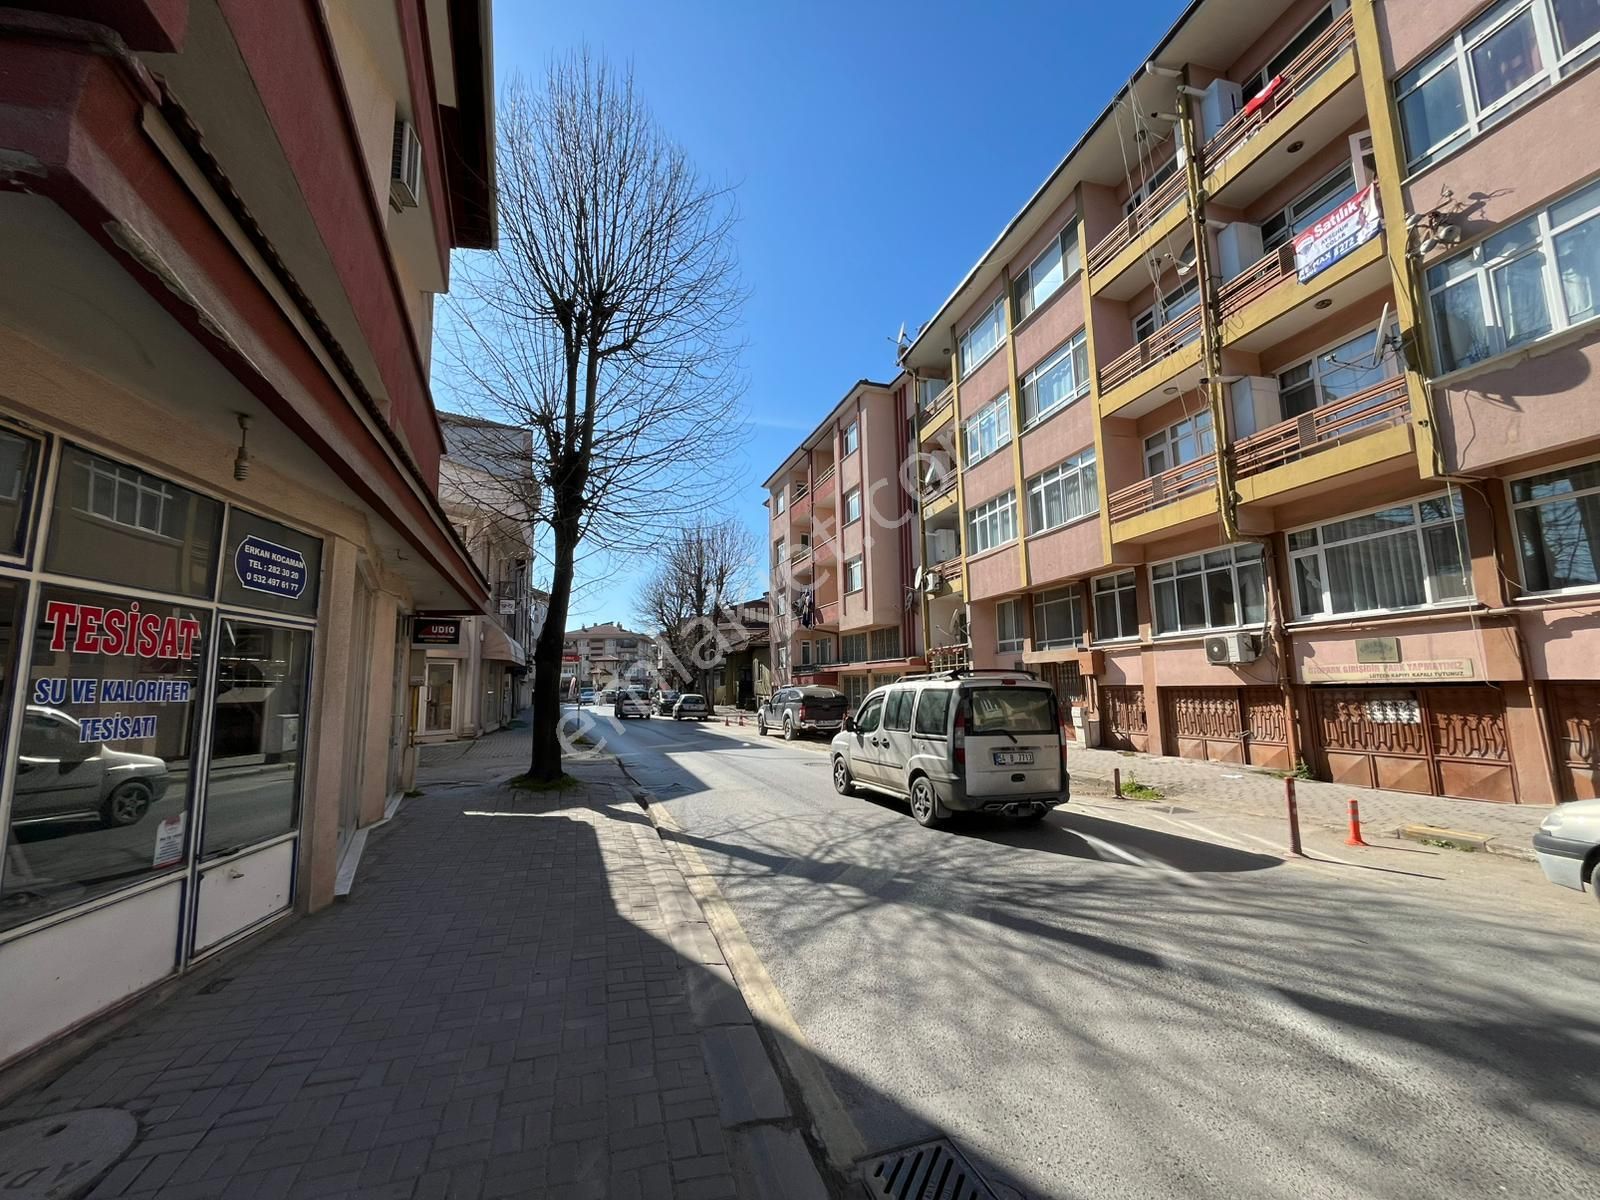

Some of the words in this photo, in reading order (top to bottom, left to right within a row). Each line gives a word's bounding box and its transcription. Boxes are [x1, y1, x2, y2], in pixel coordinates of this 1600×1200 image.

[1313, 201, 1359, 238] Satılık
[244, 544, 271, 559] ERKAN
[271, 553, 304, 569] KOCAMAN
[248, 559, 262, 570] TEL
[267, 564, 281, 575] 282
[281, 568, 290, 577] 30
[290, 571, 299, 580] 20
[252, 574, 267, 584] 532
[267, 577, 280, 587] 497
[290, 583, 299, 592] 77
[45, 601, 200, 659] TESİSAT
[34, 678, 67, 704] SU
[72, 679, 98, 704] VE
[100, 675, 191, 704] KALORİFER
[79, 712, 157, 743] TESİSATI
